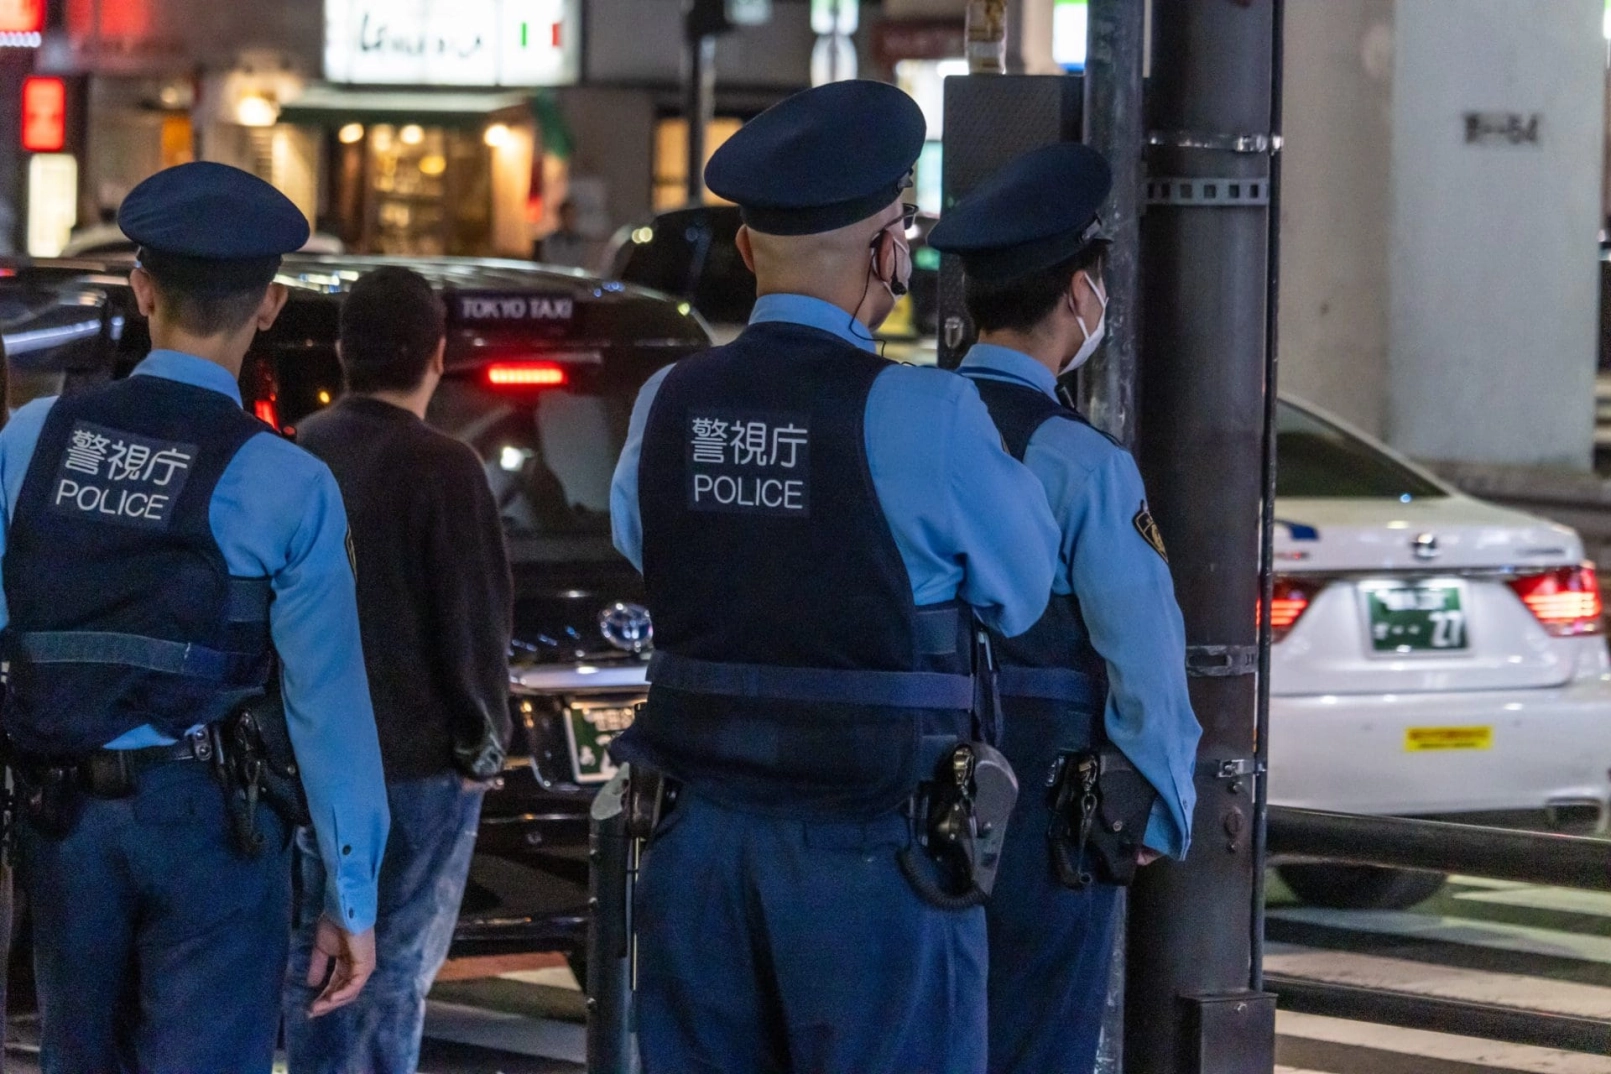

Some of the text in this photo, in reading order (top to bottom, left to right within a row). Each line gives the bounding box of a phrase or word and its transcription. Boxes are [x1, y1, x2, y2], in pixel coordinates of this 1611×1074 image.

[463, 299, 573, 319] TOKYO TAXI
[65, 430, 191, 486] 警視庁
[691, 418, 808, 468] 警視庁
[56, 479, 170, 520] POLICE
[694, 474, 804, 509] POLICE
